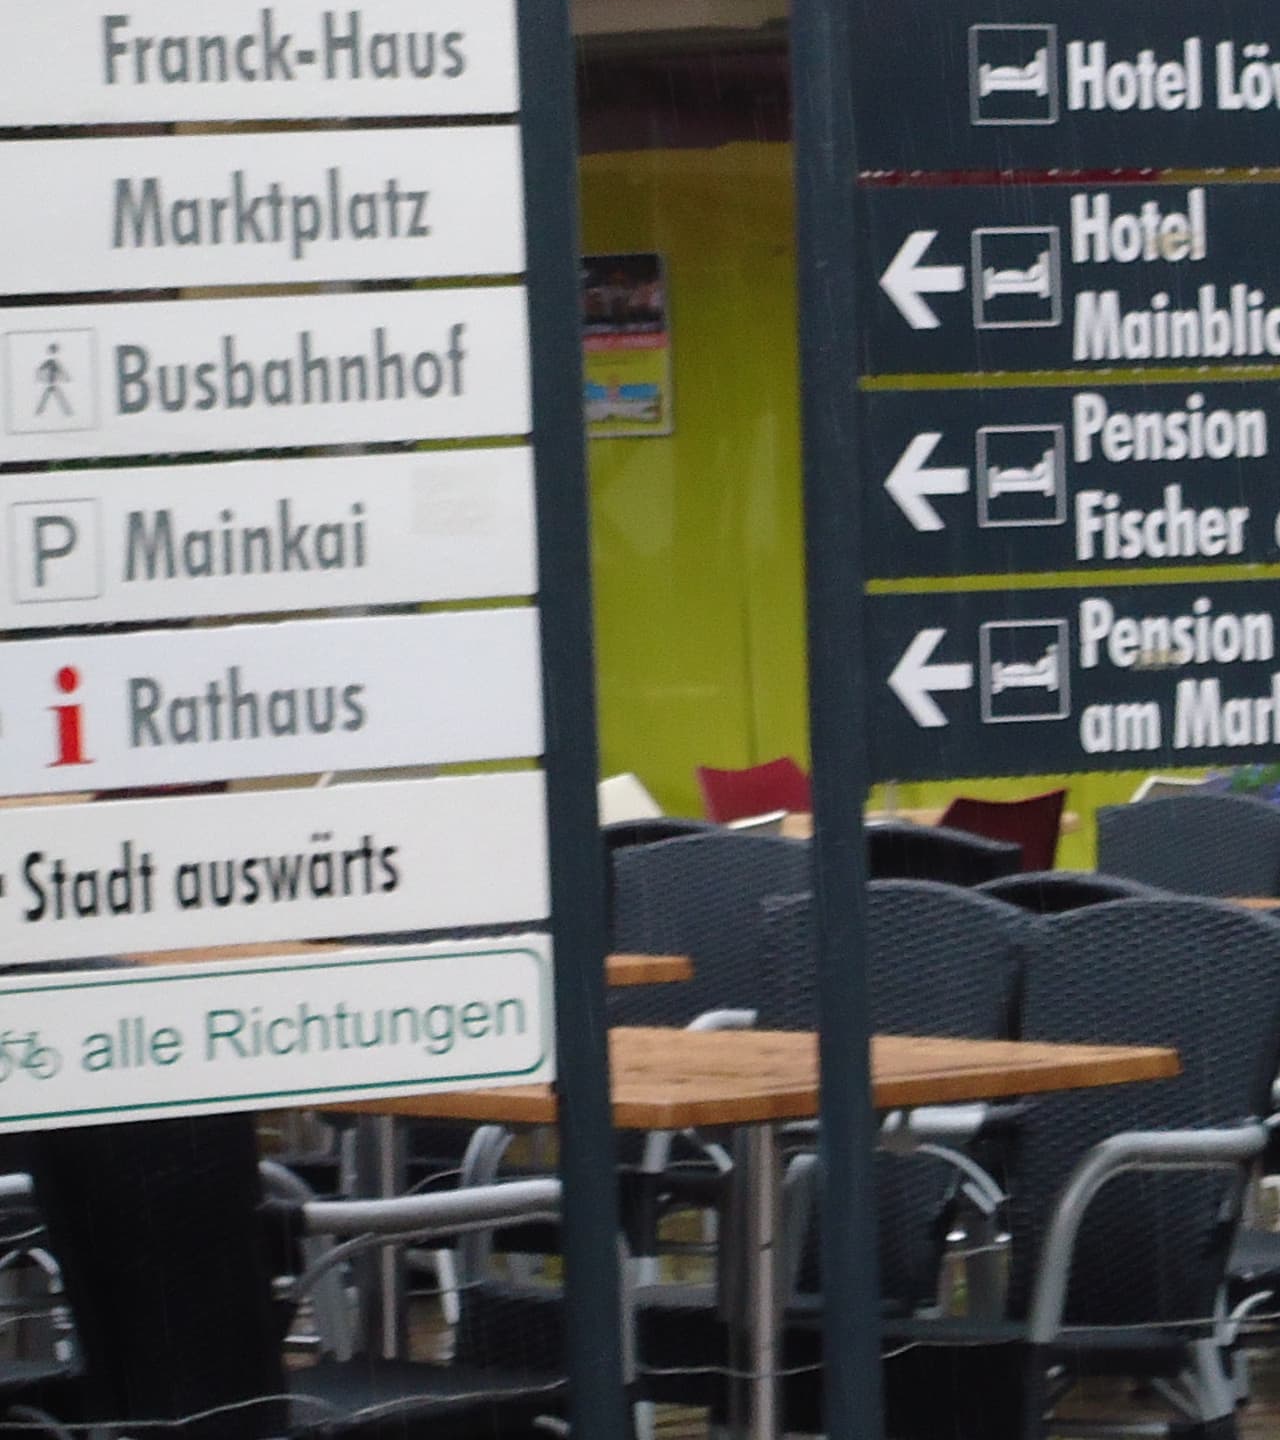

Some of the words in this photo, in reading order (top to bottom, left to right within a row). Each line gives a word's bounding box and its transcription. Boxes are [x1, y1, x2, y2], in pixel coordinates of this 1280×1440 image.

[102, 8, 465, 84] Franck-Haus
[1069, 38, 1200, 109] Hotel
[112, 168, 430, 260] Marktplatz
[1073, 189, 1204, 261] Hotel
[116, 323, 465, 414] Busbahnhof
[1076, 394, 1265, 461] Pension
[33, 516, 77, 587] P
[125, 499, 364, 581] Mainkai
[1077, 486, 1247, 559] Fischer
[1082, 599, 1272, 667] Pension
[129, 666, 364, 747] Rathaus
[1084, 704, 1158, 752] am
[23, 842, 153, 922] Stadt
[176, 833, 398, 909] auswärts
[83, 1018, 181, 1072] alle
[205, 996, 527, 1054] Richtungen
